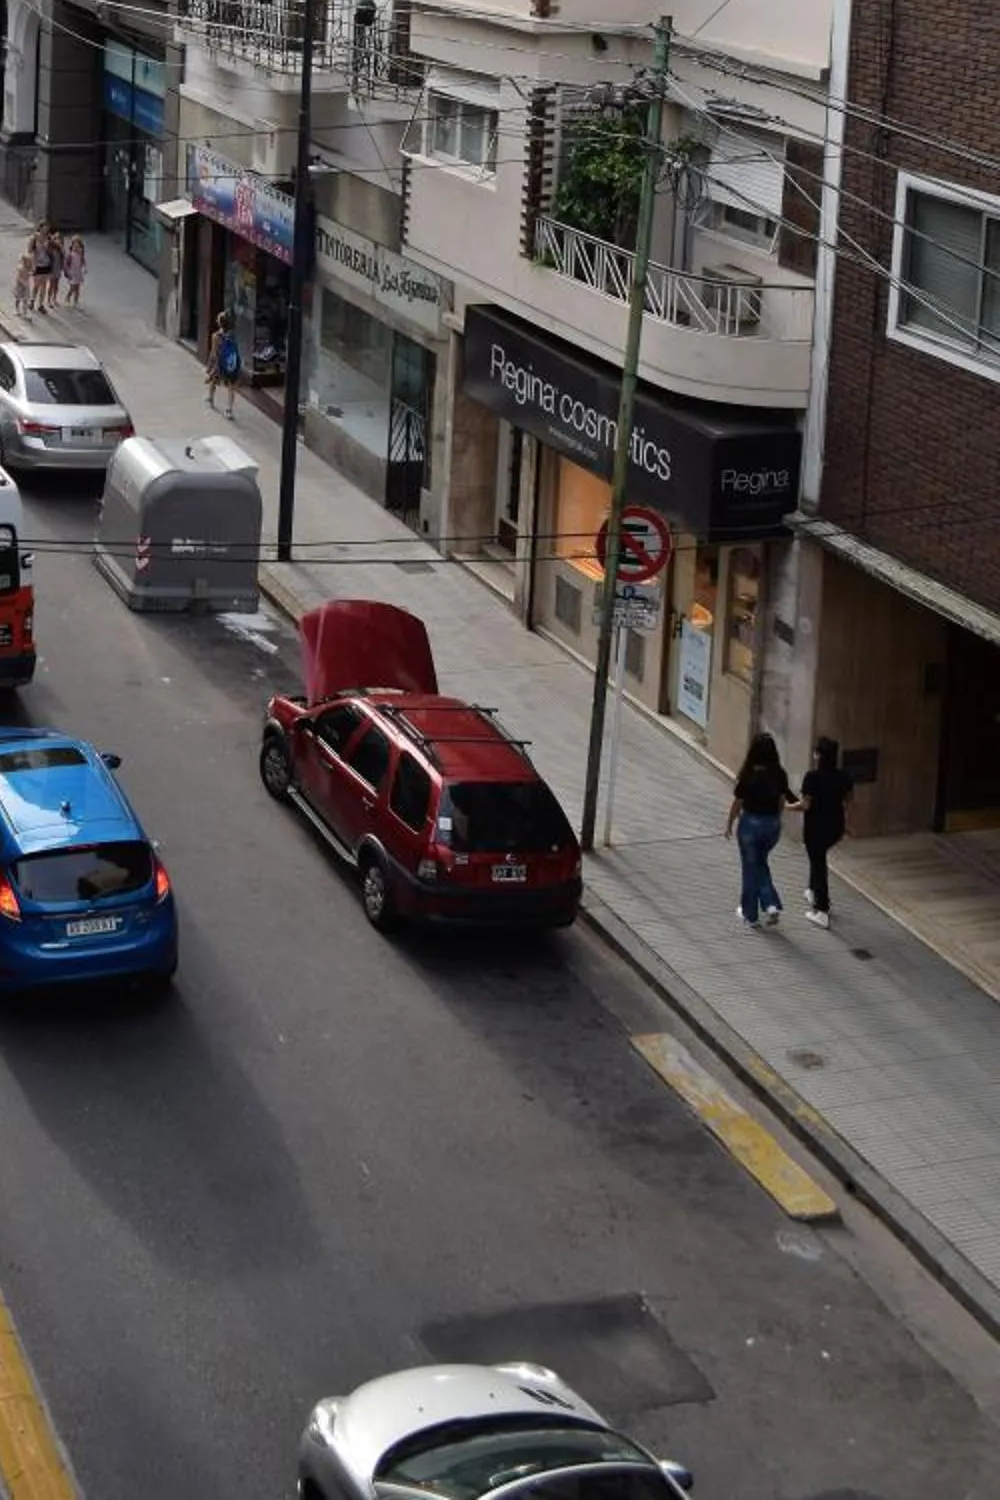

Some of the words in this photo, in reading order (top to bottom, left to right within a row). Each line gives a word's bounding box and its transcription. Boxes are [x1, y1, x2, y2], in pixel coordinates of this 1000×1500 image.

[490, 344, 556, 415] Regina
[559, 393, 671, 481] cosmtics
[721, 469, 789, 496] Regina
